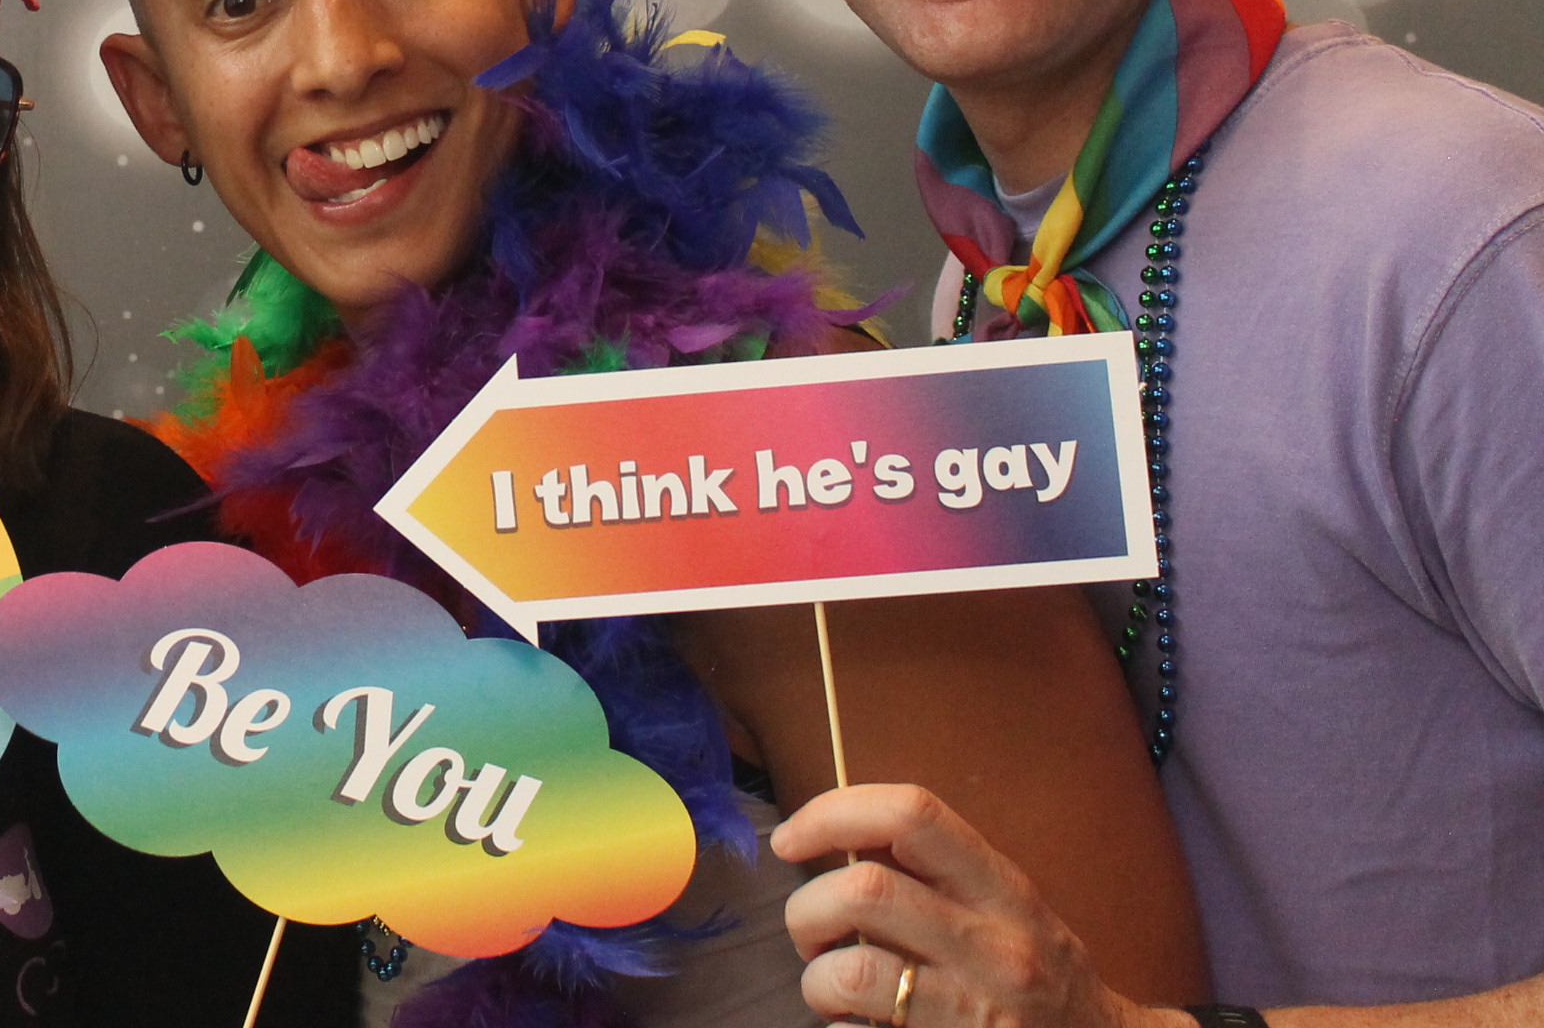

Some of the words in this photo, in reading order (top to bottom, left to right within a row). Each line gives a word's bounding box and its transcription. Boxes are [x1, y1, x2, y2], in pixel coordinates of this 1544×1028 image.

[491, 469, 519, 533] I
[534, 454, 738, 528] think
[756, 440, 915, 512] he's
[934, 439, 1078, 510] gay
[132, 627, 292, 766] Be
[314, 685, 544, 855] You
